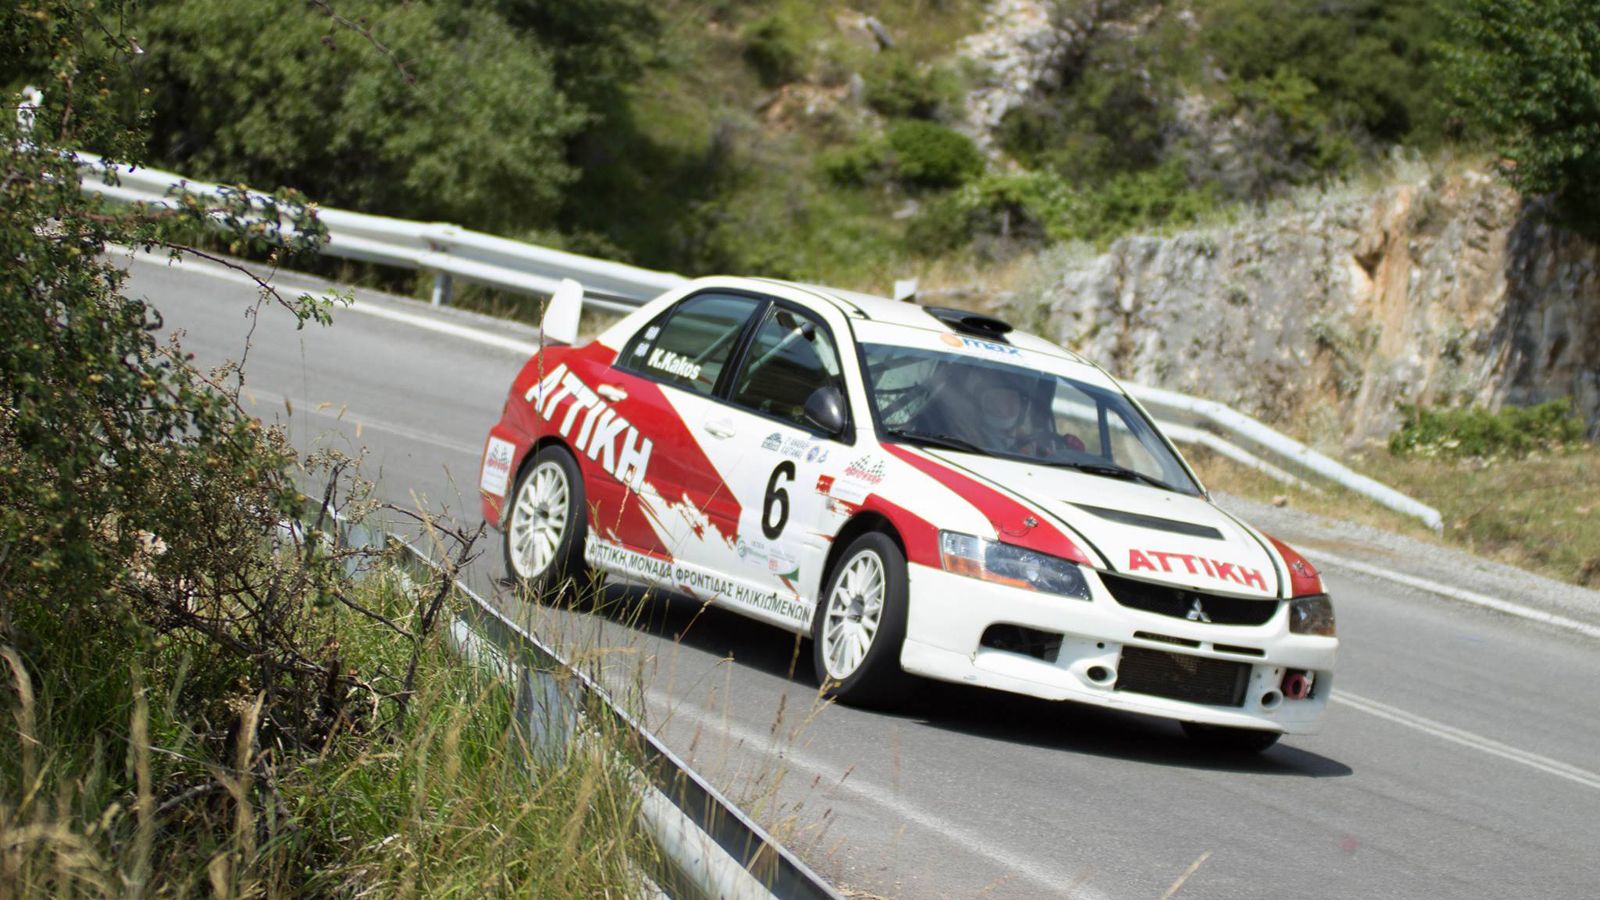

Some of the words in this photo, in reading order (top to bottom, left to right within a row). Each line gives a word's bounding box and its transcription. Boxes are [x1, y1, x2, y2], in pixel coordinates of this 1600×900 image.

[647, 347, 702, 380] K.Kakos
[524, 362, 653, 494] ΑΤΤΙΚΗ
[761, 460, 796, 541] 6
[675, 567, 734, 598] ΦΡΟΝΤΙΔΑΣ
[1129, 548, 1269, 592] ΑΤΤΙΚΗ
